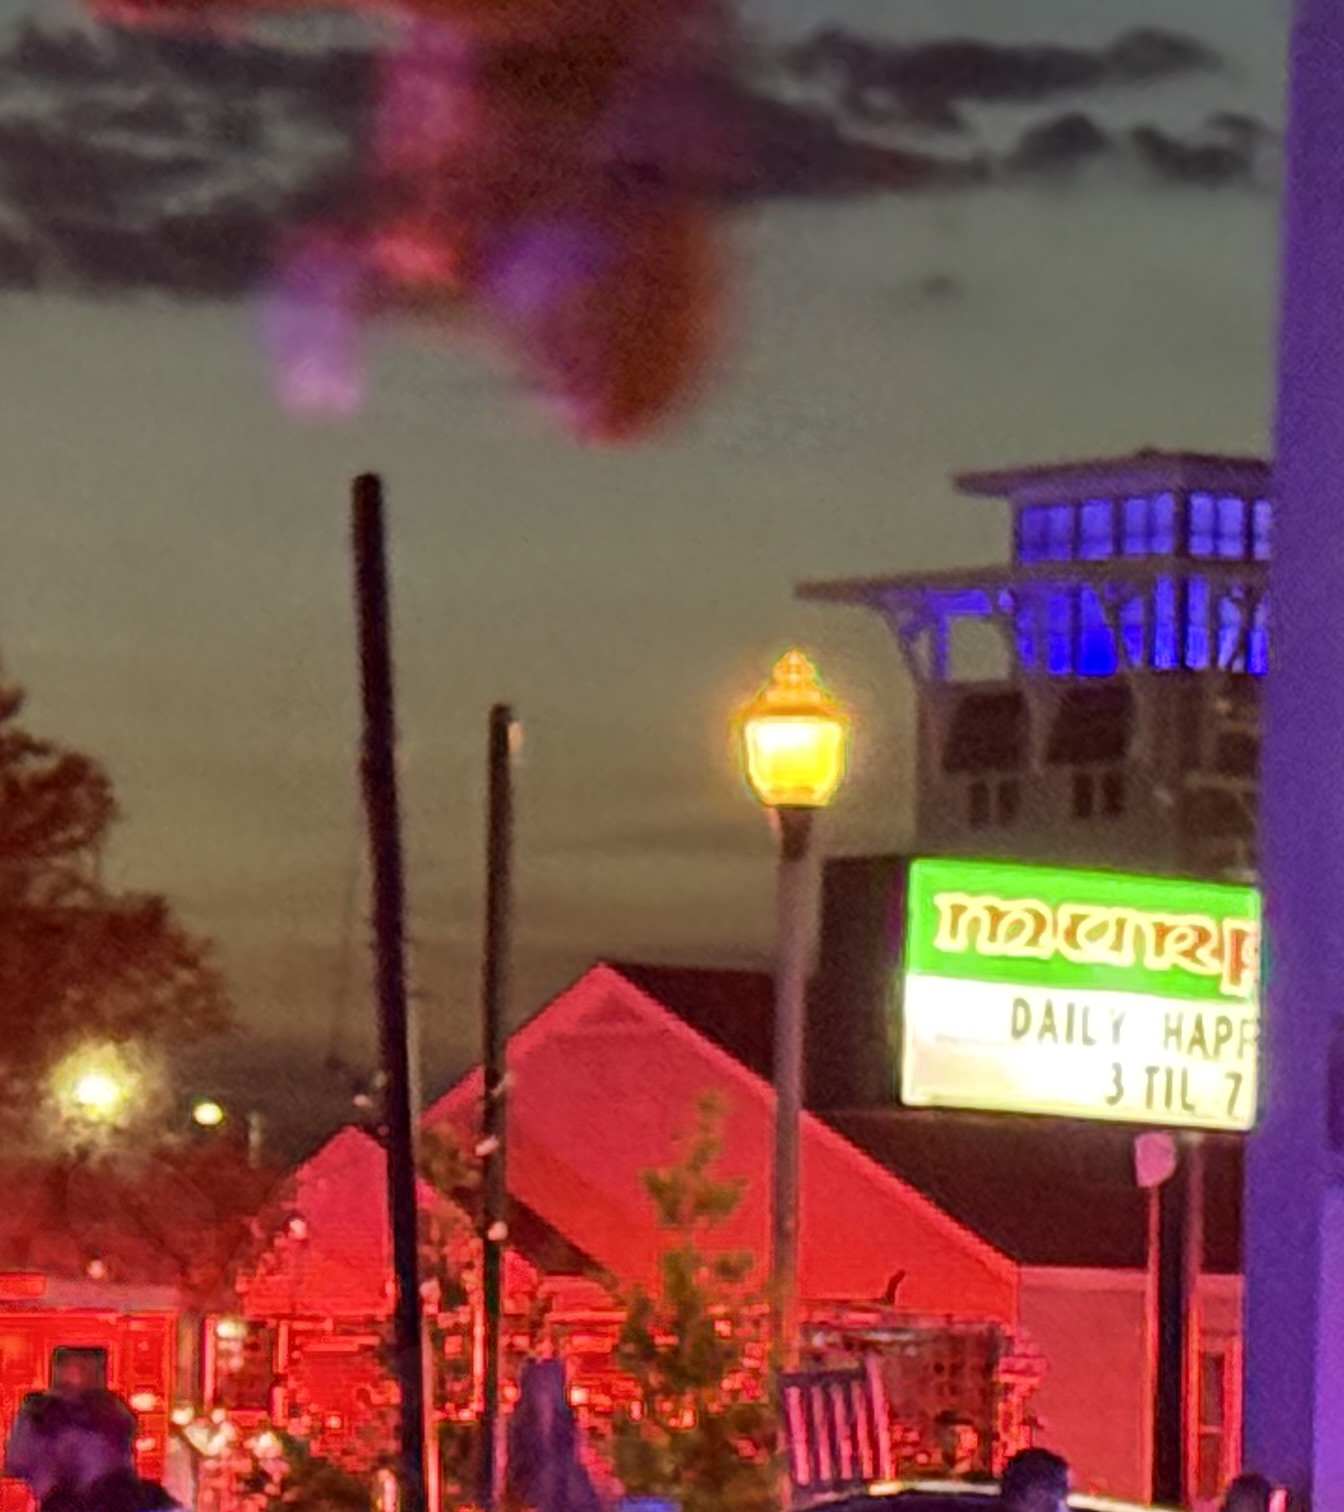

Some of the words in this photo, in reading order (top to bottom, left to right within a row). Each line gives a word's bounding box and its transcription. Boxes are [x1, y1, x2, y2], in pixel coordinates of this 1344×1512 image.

[1010, 997, 1127, 1046] DAILY
[1105, 1061, 1124, 1107] 3
[1144, 1065, 1196, 1112] TIL
[1224, 1071, 1243, 1117] 7
